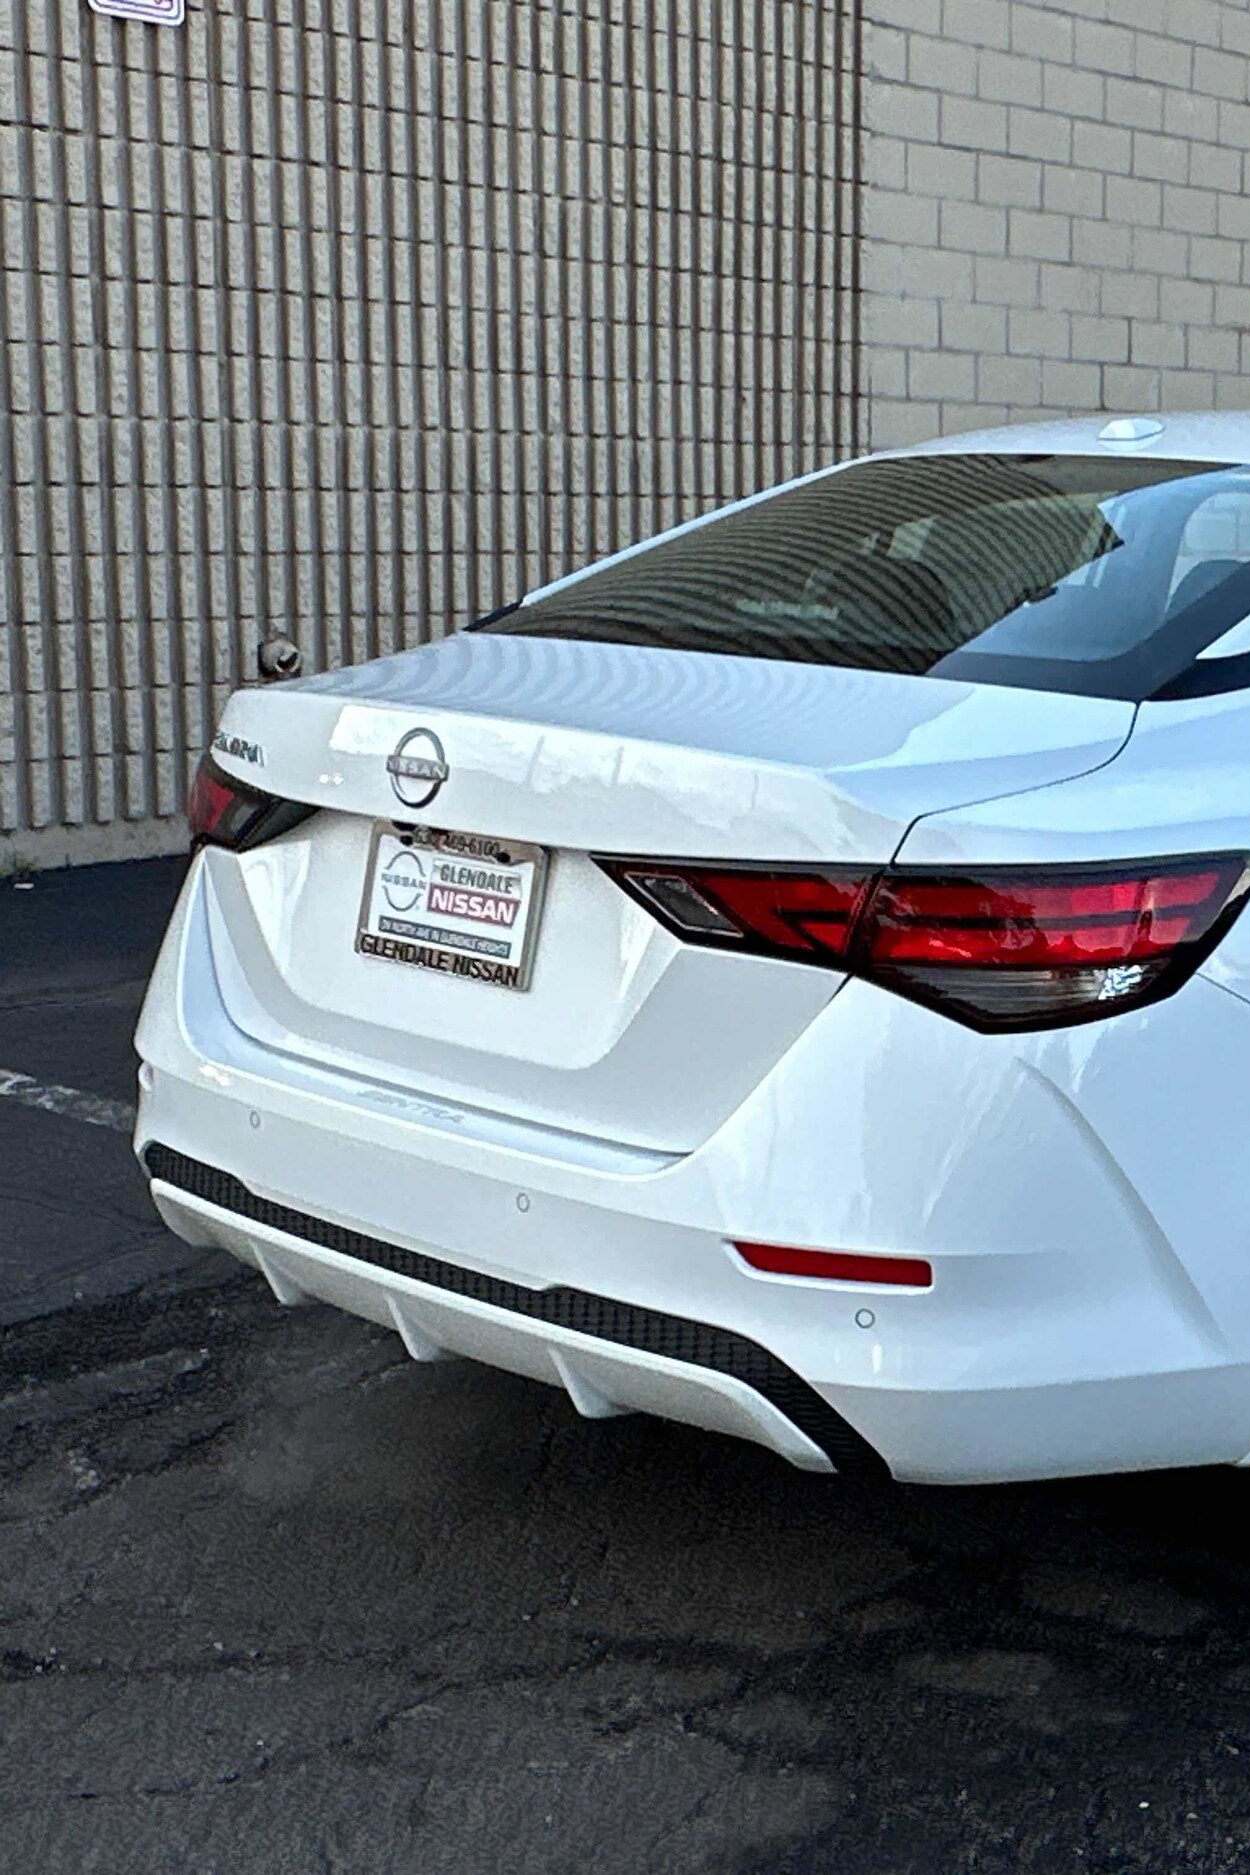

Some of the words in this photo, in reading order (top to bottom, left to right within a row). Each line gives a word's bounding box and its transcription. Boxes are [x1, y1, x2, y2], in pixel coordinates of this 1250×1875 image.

[440, 863, 513, 894] GLENDALE
[431, 888, 515, 923] NISSAN
[360, 934, 450, 970] GLENDALE
[452, 956, 520, 987] NISSAN
